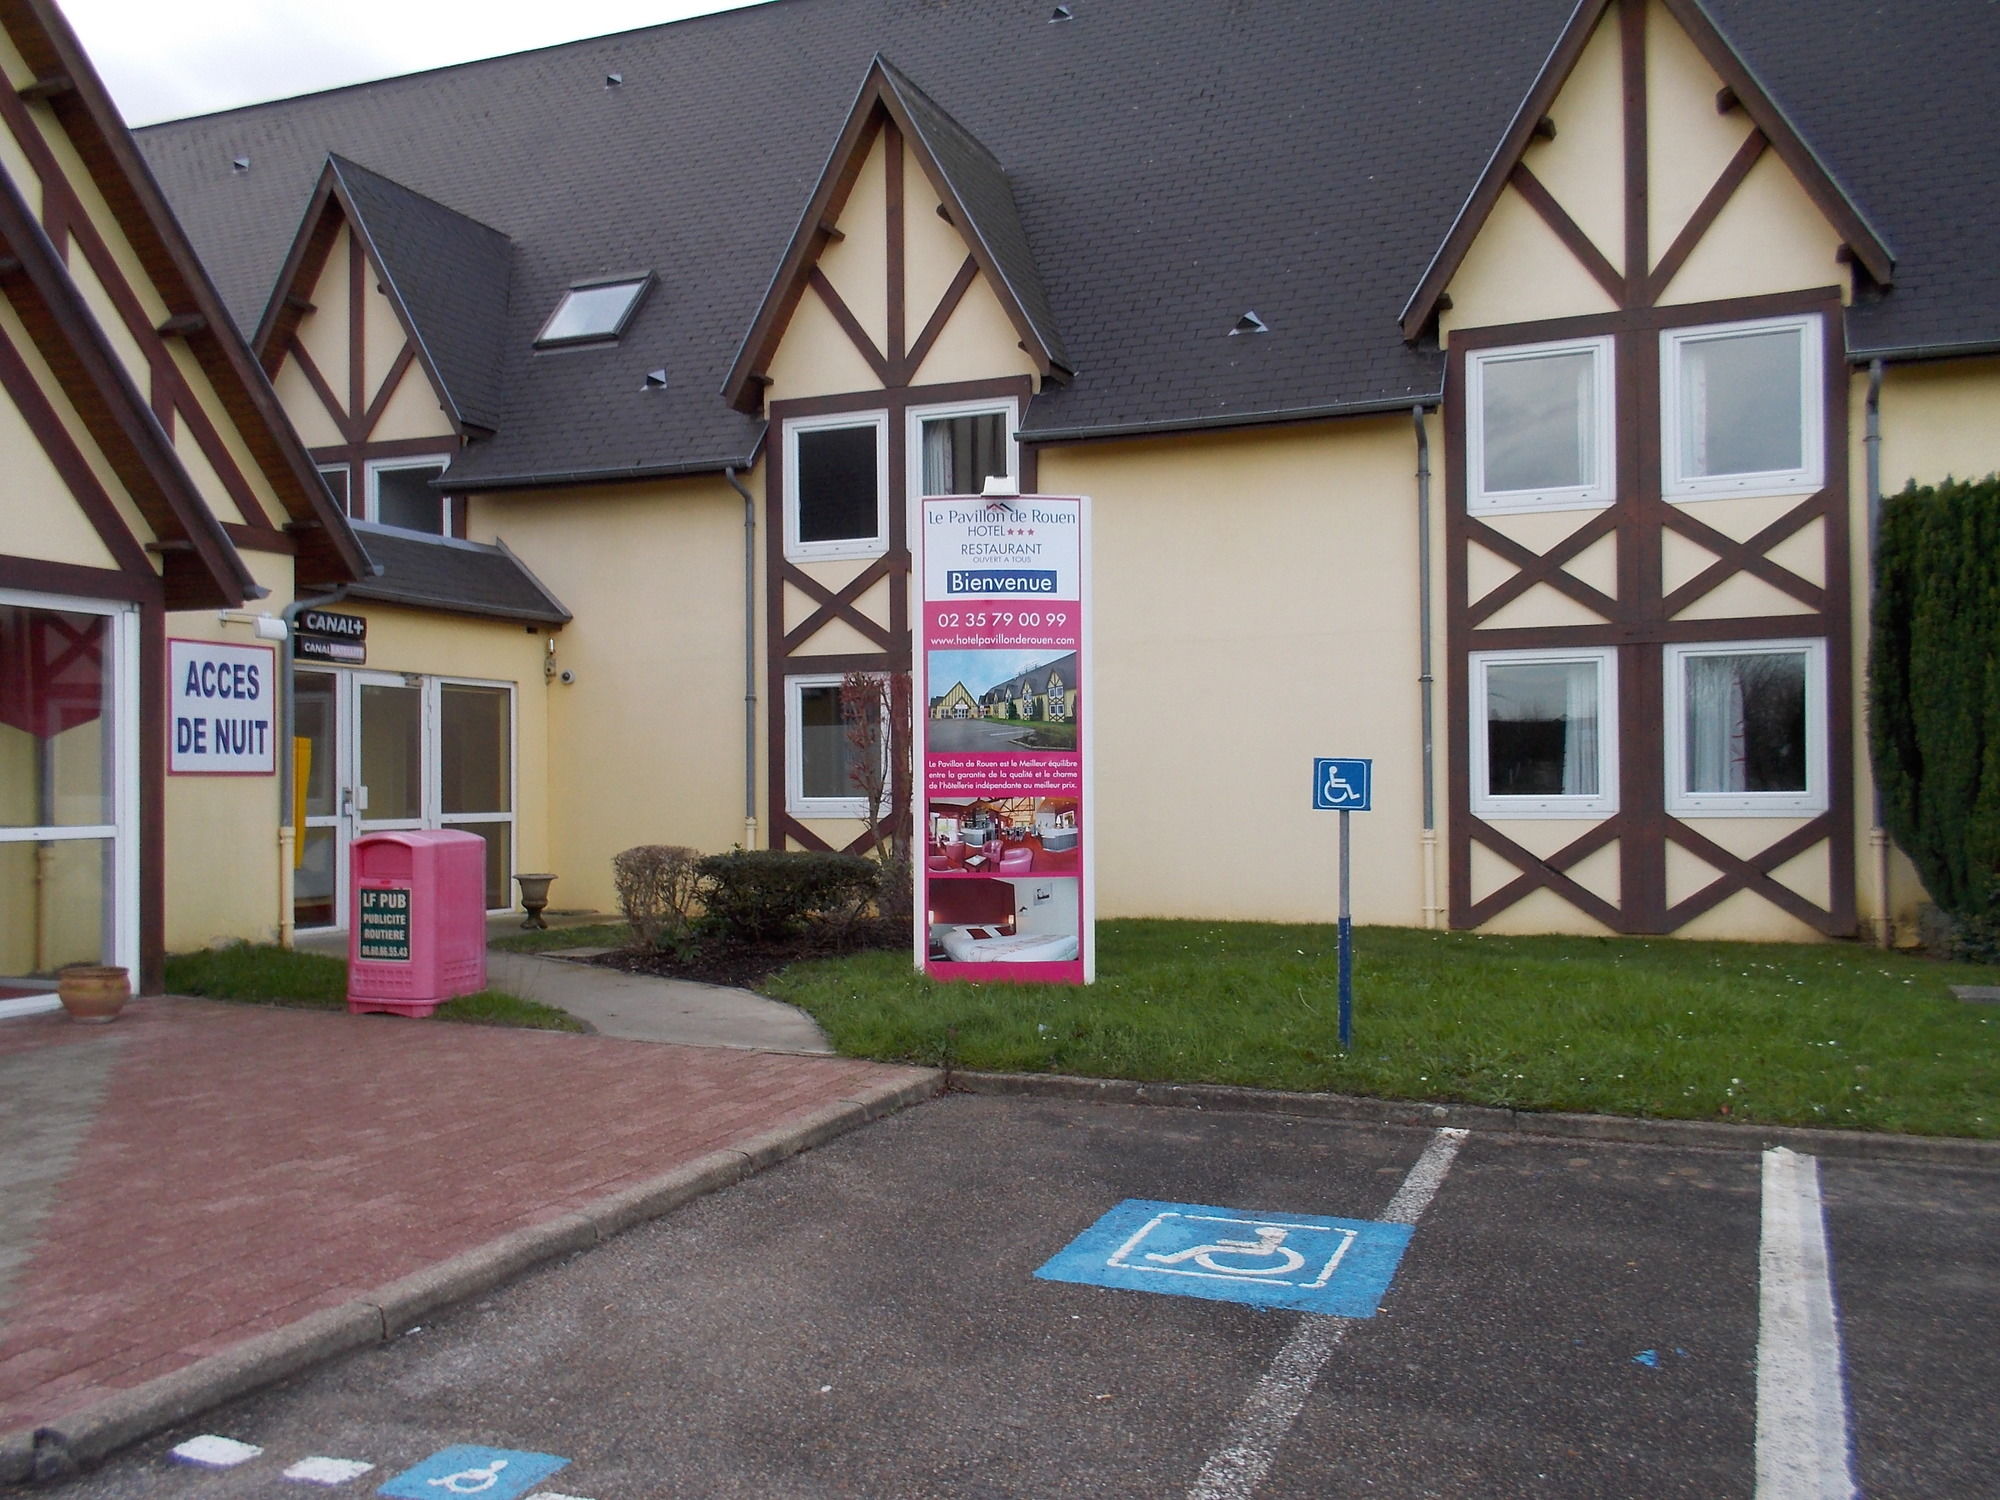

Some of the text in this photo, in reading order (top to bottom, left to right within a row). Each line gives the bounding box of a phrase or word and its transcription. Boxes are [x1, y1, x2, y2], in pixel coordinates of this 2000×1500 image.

[929, 509, 1076, 524] Le Pavillon de Rouen
[967, 526, 1005, 537] HOTEL
[961, 543, 1042, 555] RESTAURANT
[952, 572, 1052, 591] Bienvenue
[306, 614, 364, 635] CANAL+
[938, 613, 1066, 627] 02 35 79 00 99
[930, 633, 1075, 648] www.hotelpavillonderouen.com
[185, 660, 260, 700] ACCES
[177, 717, 268, 755] DE NUIT
[928, 760, 937, 768] Le
[1011, 759, 1018, 767] le
[1019, 759, 1047, 767] Meilleur
[1048, 759, 1078, 769] équilibre
[928, 769, 1078, 780] entre la garantie de la qualité et le charme
[928, 781, 938, 789] de
[975, 780, 1022, 791] indépendante
[1034, 780, 1060, 789] meilleur
[1061, 781, 1078, 791] prix.
[363, 893, 407, 908] LF PUB
[363, 913, 407, 925] PUBLICITE
[364, 928, 405, 940] ROUTIERE
